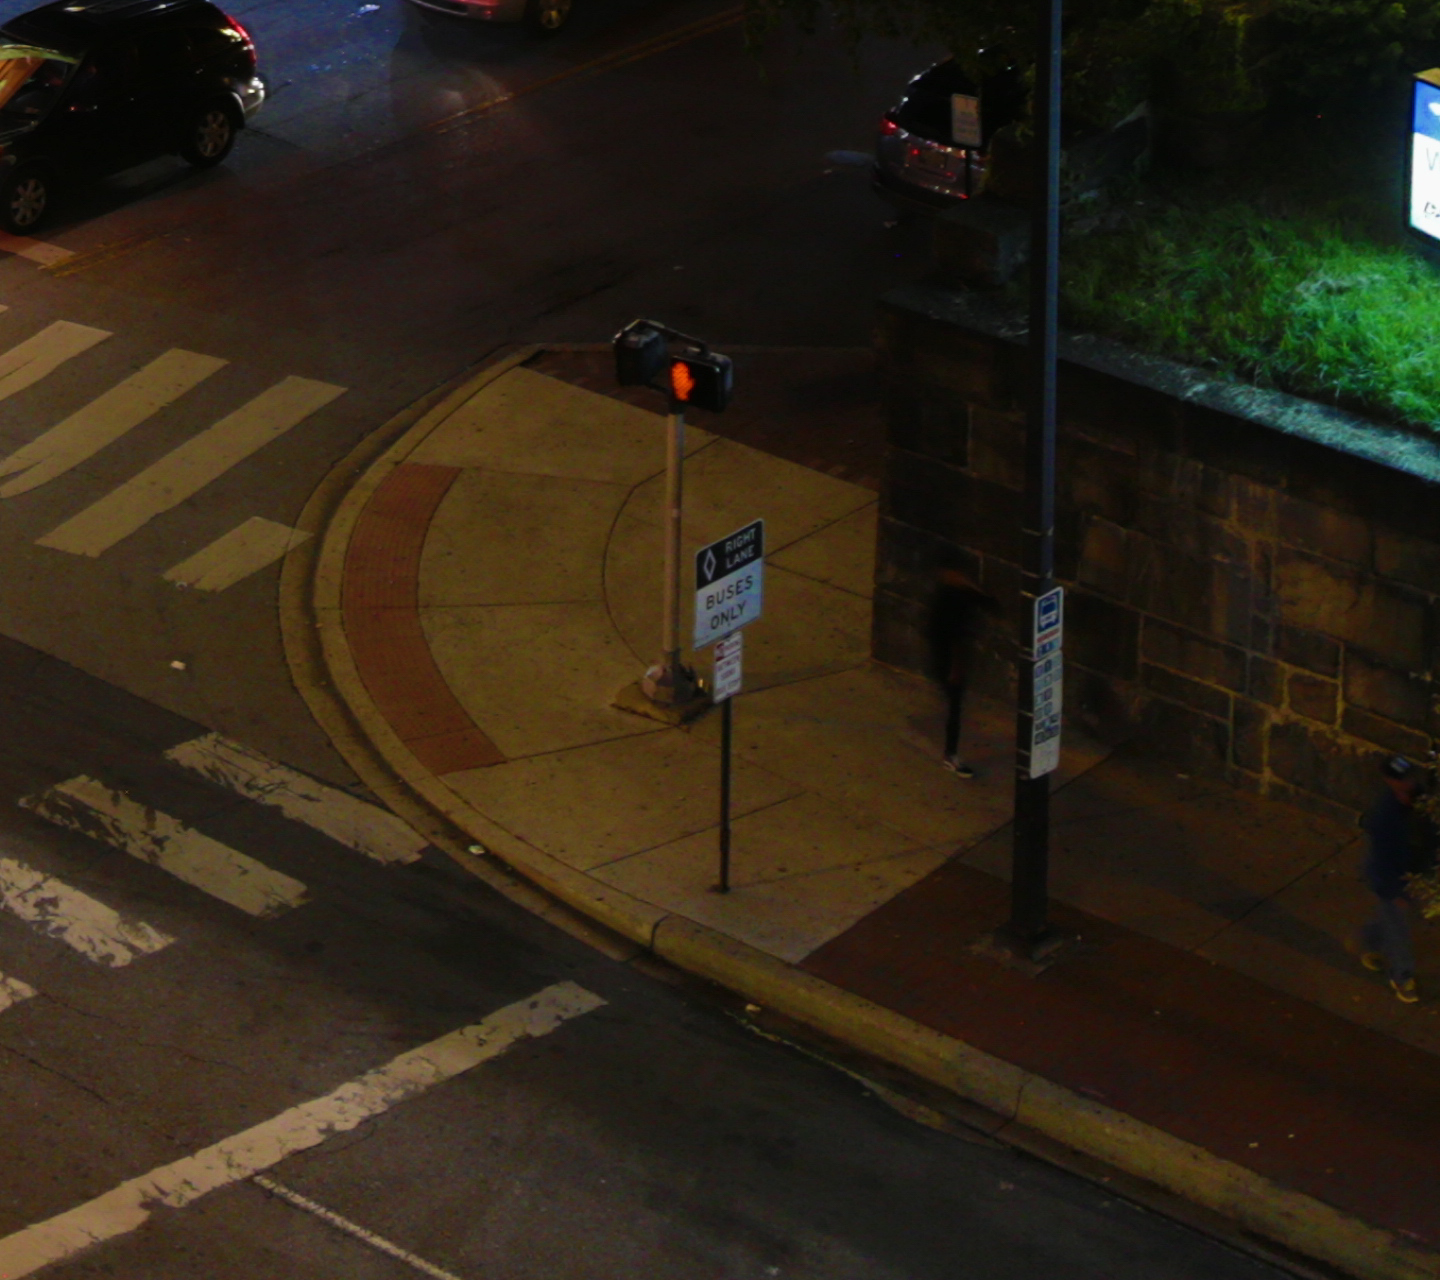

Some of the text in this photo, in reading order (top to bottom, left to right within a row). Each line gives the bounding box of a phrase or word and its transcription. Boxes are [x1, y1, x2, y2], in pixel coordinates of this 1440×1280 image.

[725, 527, 757, 553] RIGHT
[726, 545, 755, 569] LANE
[706, 575, 754, 611] BUSES
[710, 599, 746, 630] ONLY
